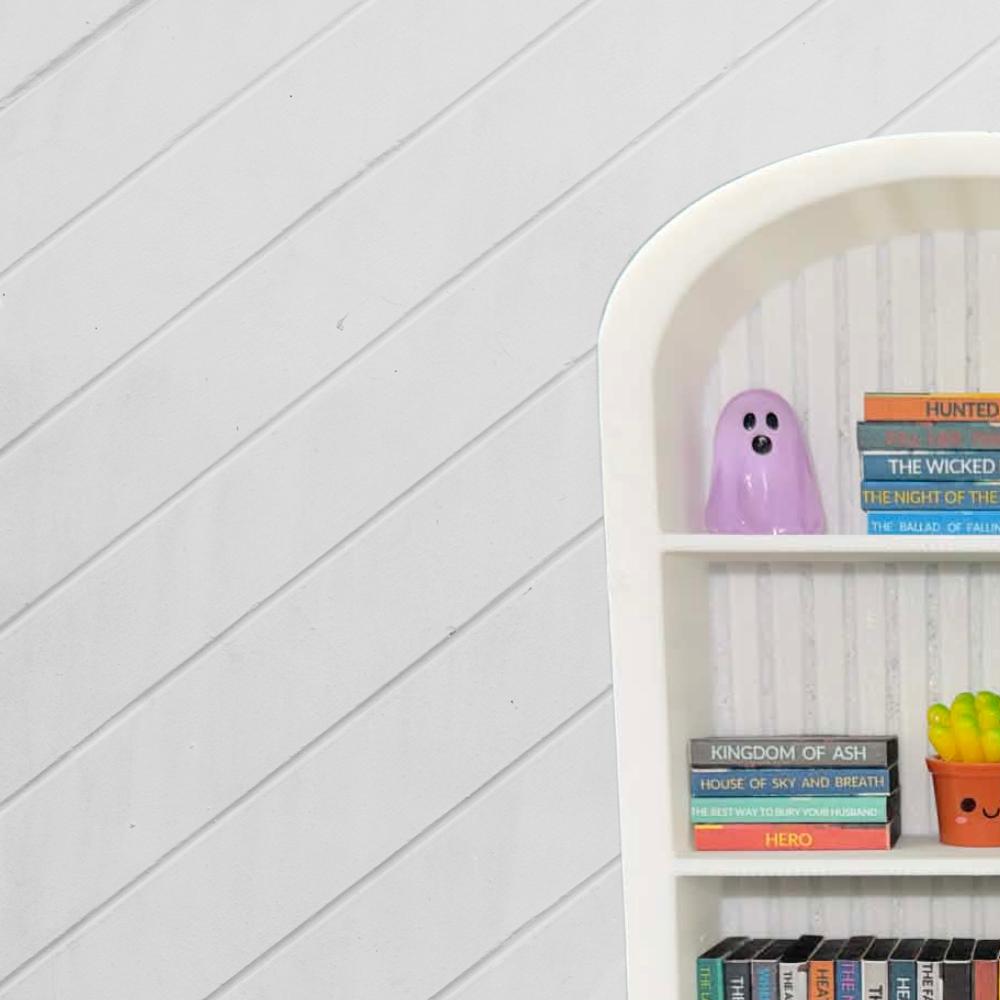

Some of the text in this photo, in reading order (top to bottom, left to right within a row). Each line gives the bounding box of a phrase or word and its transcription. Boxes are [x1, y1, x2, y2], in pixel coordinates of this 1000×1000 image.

[926, 401, 1000, 417] HUNTED
[888, 458, 923, 474] THE
[926, 458, 995, 474] WICKED
[863, 490, 889, 504] THE
[894, 490, 940, 504] NIGHT
[944, 490, 964, 504] OF
[968, 490, 1000, 504] THE
[871, 521, 893, 531] THE
[901, 521, 941, 532] BALLAD
[948, 522, 963, 532] OF
[711, 745, 867, 761] KINGDOM OF ASH
[701, 775, 885, 790] HOUSE OF SKY AND BREATH
[765, 832, 813, 847] HERO
[783, 972, 793, 991] THE
[841, 963, 855, 991] THE
[922, 963, 933, 986] THE
